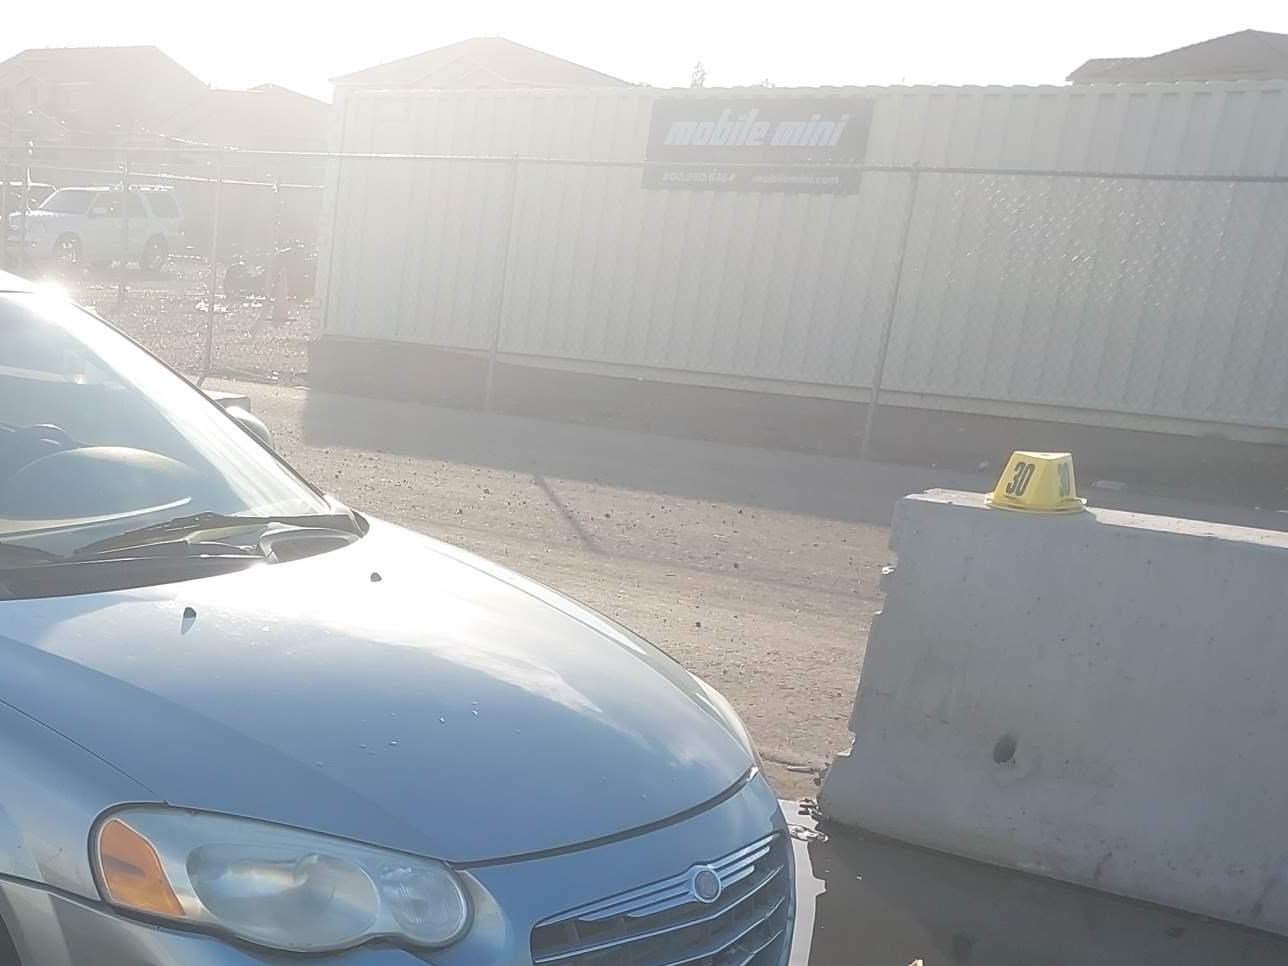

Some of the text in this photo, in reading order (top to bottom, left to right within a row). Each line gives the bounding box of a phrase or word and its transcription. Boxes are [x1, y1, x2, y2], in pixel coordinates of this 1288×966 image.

[663, 108, 855, 146] mobile mini
[1005, 461, 1036, 496] 30
